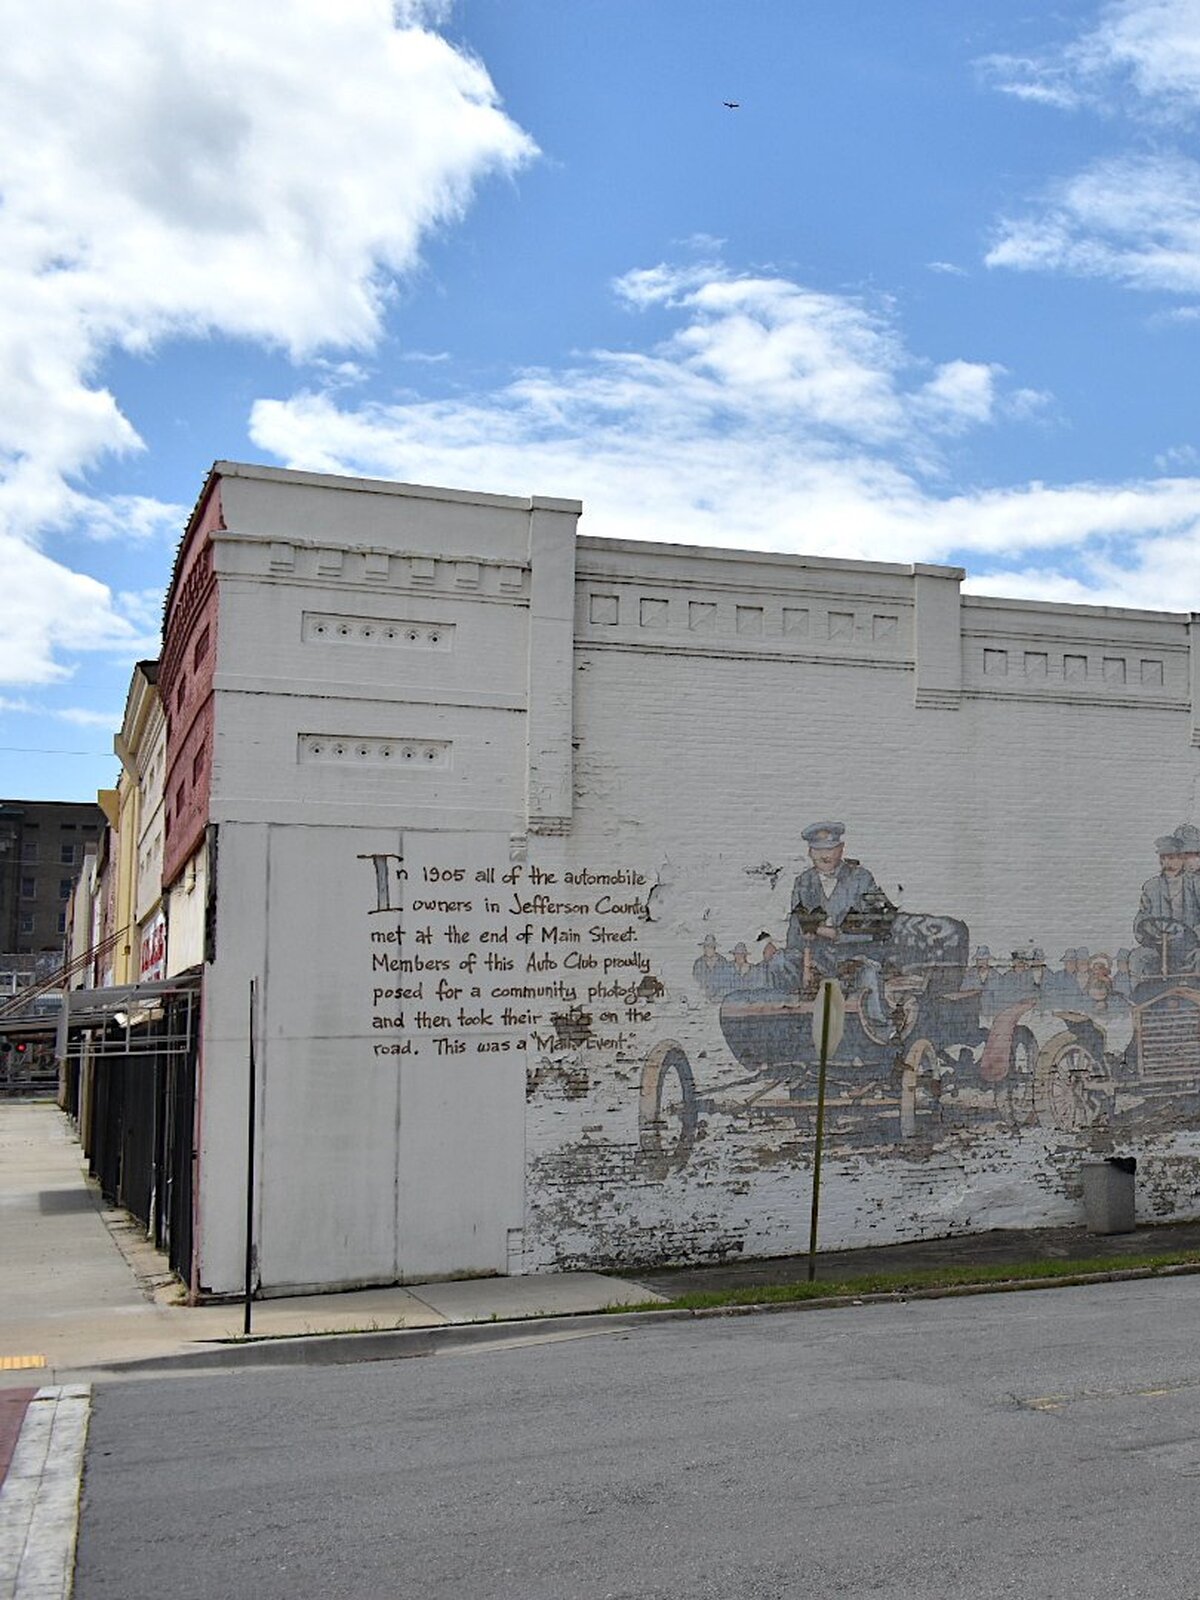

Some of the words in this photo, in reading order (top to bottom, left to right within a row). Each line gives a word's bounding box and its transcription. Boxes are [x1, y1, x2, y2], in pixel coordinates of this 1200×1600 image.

[357, 854, 409, 915] In
[423, 867, 466, 882] 1905
[475, 868, 494, 883] all
[502, 865, 522, 885] of
[528, 865, 558, 885] the
[564, 868, 647, 885] automobile
[412, 900, 473, 913] owners
[485, 898, 500, 913] in
[509, 893, 589, 915] Jefferson
[595, 896, 651, 920] County
[371, 925, 406, 945] met
[415, 926, 433, 944] at
[444, 924, 470, 944] the
[479, 926, 508, 943] end
[516, 924, 533, 944] of
[541, 927, 581, 944] Main
[589, 926, 638, 943] Street.
[372, 953, 450, 973] Members
[459, 952, 477, 974] of
[484, 952, 514, 971] this
[526, 951, 558, 973] Auto
[563, 951, 598, 969] Club
[603, 951, 651, 974] proudly
[373, 982, 423, 1006] posed
[435, 978, 463, 1001] for
[470, 986, 481, 998] a
[491, 980, 577, 1001] community
[372, 1012, 405, 1029] and
[414, 1011, 451, 1029] then
[457, 1007, 493, 1027] took
[501, 1007, 542, 1024] their
[599, 1011, 618, 1023] on
[625, 1008, 652, 1022] the
[373, 1040, 419, 1056] road.
[432, 1038, 466, 1055] This
[477, 1040, 511, 1053] was
[516, 1039, 527, 1051] a
